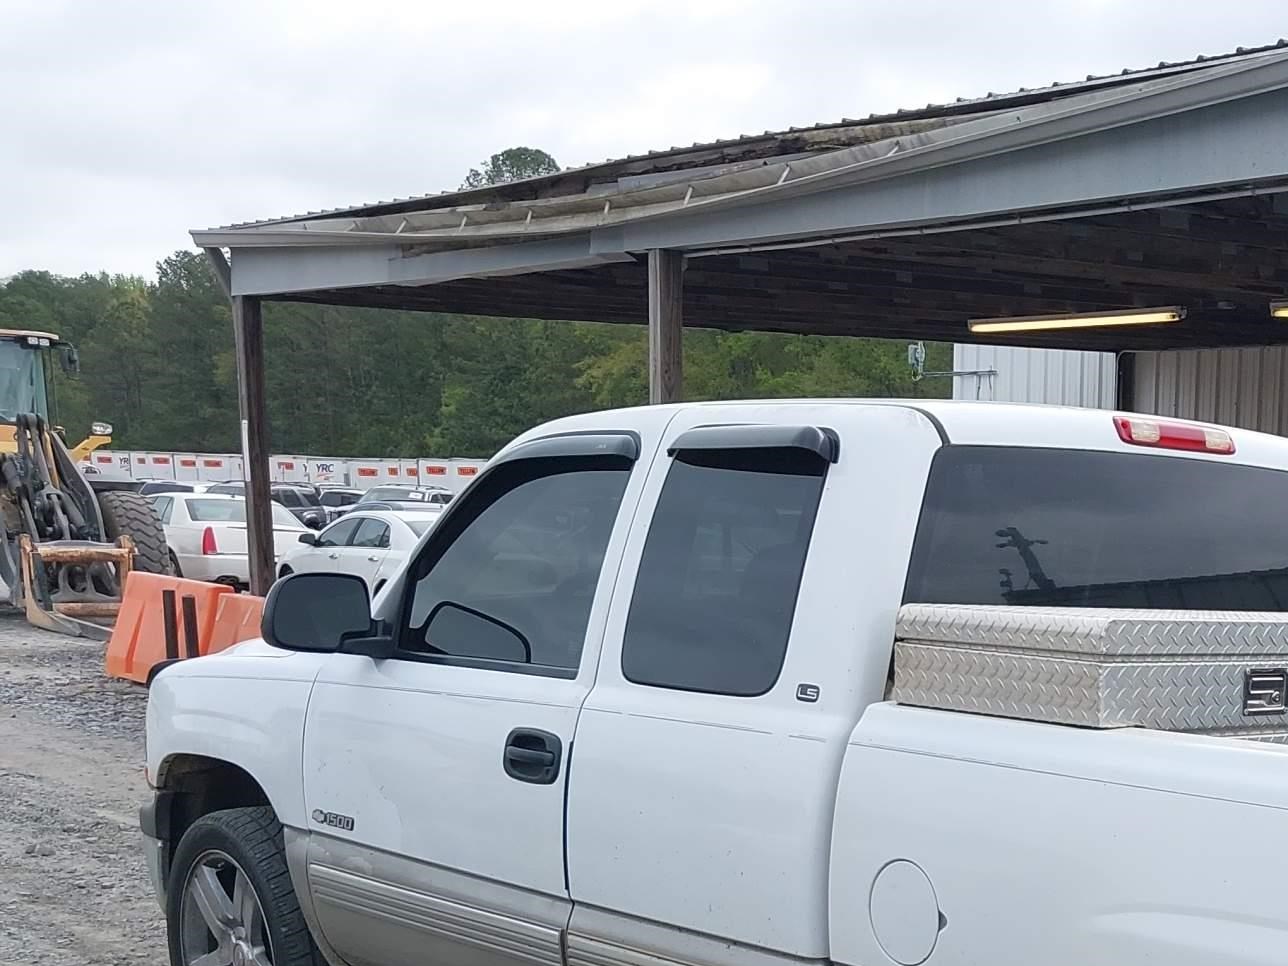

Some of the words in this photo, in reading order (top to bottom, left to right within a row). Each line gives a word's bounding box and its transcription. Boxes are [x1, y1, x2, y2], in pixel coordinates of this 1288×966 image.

[316, 463, 334, 473] YRC
[797, 686, 819, 700] LS
[326, 811, 354, 831] 1500
